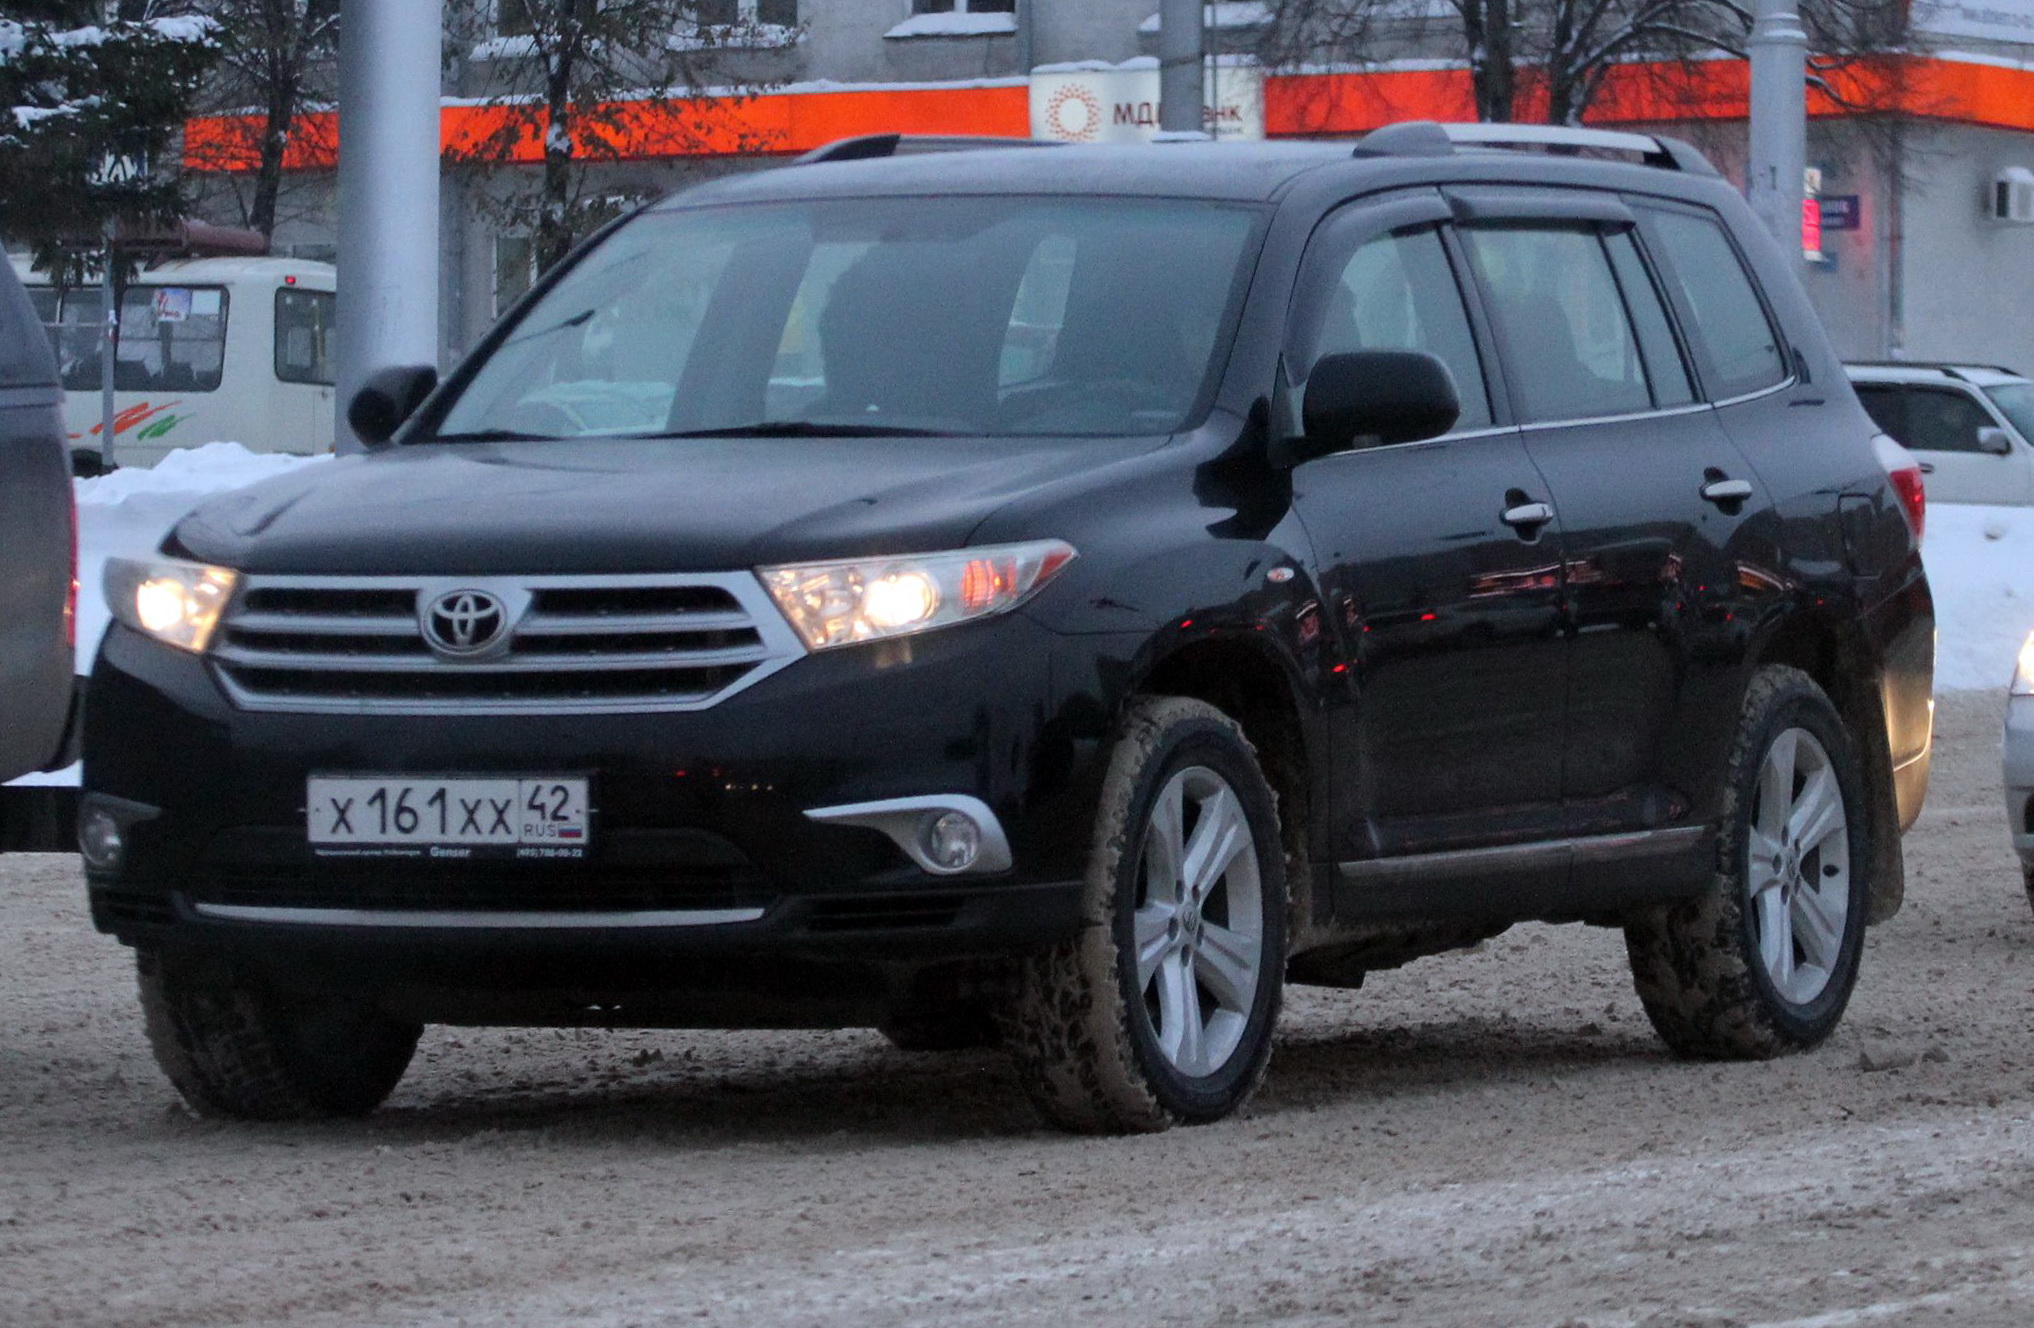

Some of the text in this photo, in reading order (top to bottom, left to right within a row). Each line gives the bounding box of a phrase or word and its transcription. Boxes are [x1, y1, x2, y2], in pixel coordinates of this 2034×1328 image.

[1113, 102, 1161, 125] МД
[527, 785, 570, 821] 42
[523, 823, 556, 837] RUS
